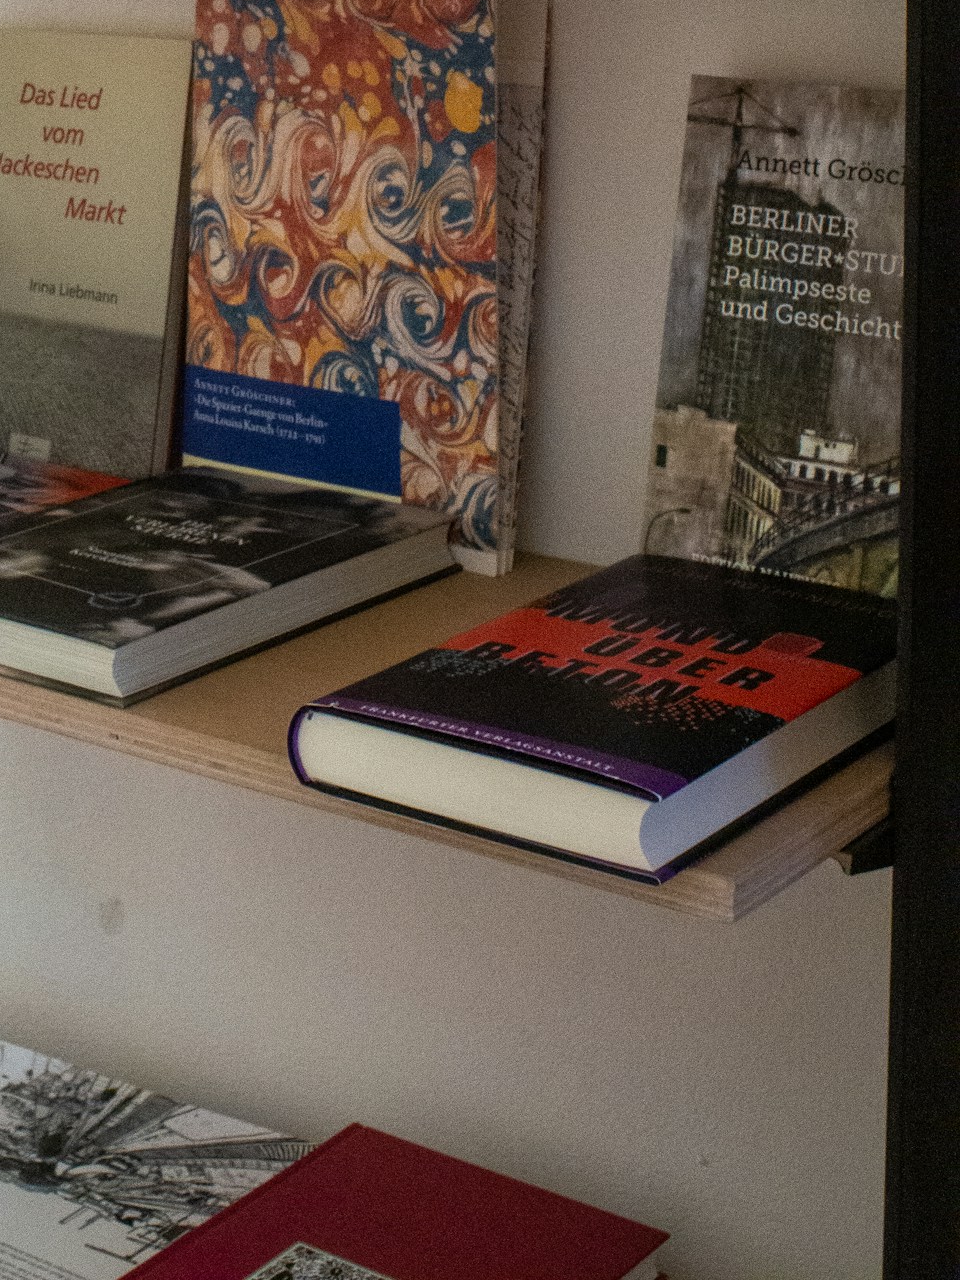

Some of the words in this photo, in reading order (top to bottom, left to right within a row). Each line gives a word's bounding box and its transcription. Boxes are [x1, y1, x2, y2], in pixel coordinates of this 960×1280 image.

[19, 81, 56, 107] Das
[59, 85, 104, 111] Lied
[41, 125, 86, 146] vom
[739, 150, 821, 178] Annett
[64, 196, 127, 226] Markt
[730, 204, 859, 239] BERLINER
[28, 279, 56, 295] Irina
[59, 282, 118, 306] Liebmann
[723, 265, 873, 305] Palimpseste
[720, 299, 769, 322] und
[775, 302, 903, 341] Geschicht
[472, 728, 616, 773] VERLAGSANSTALT
